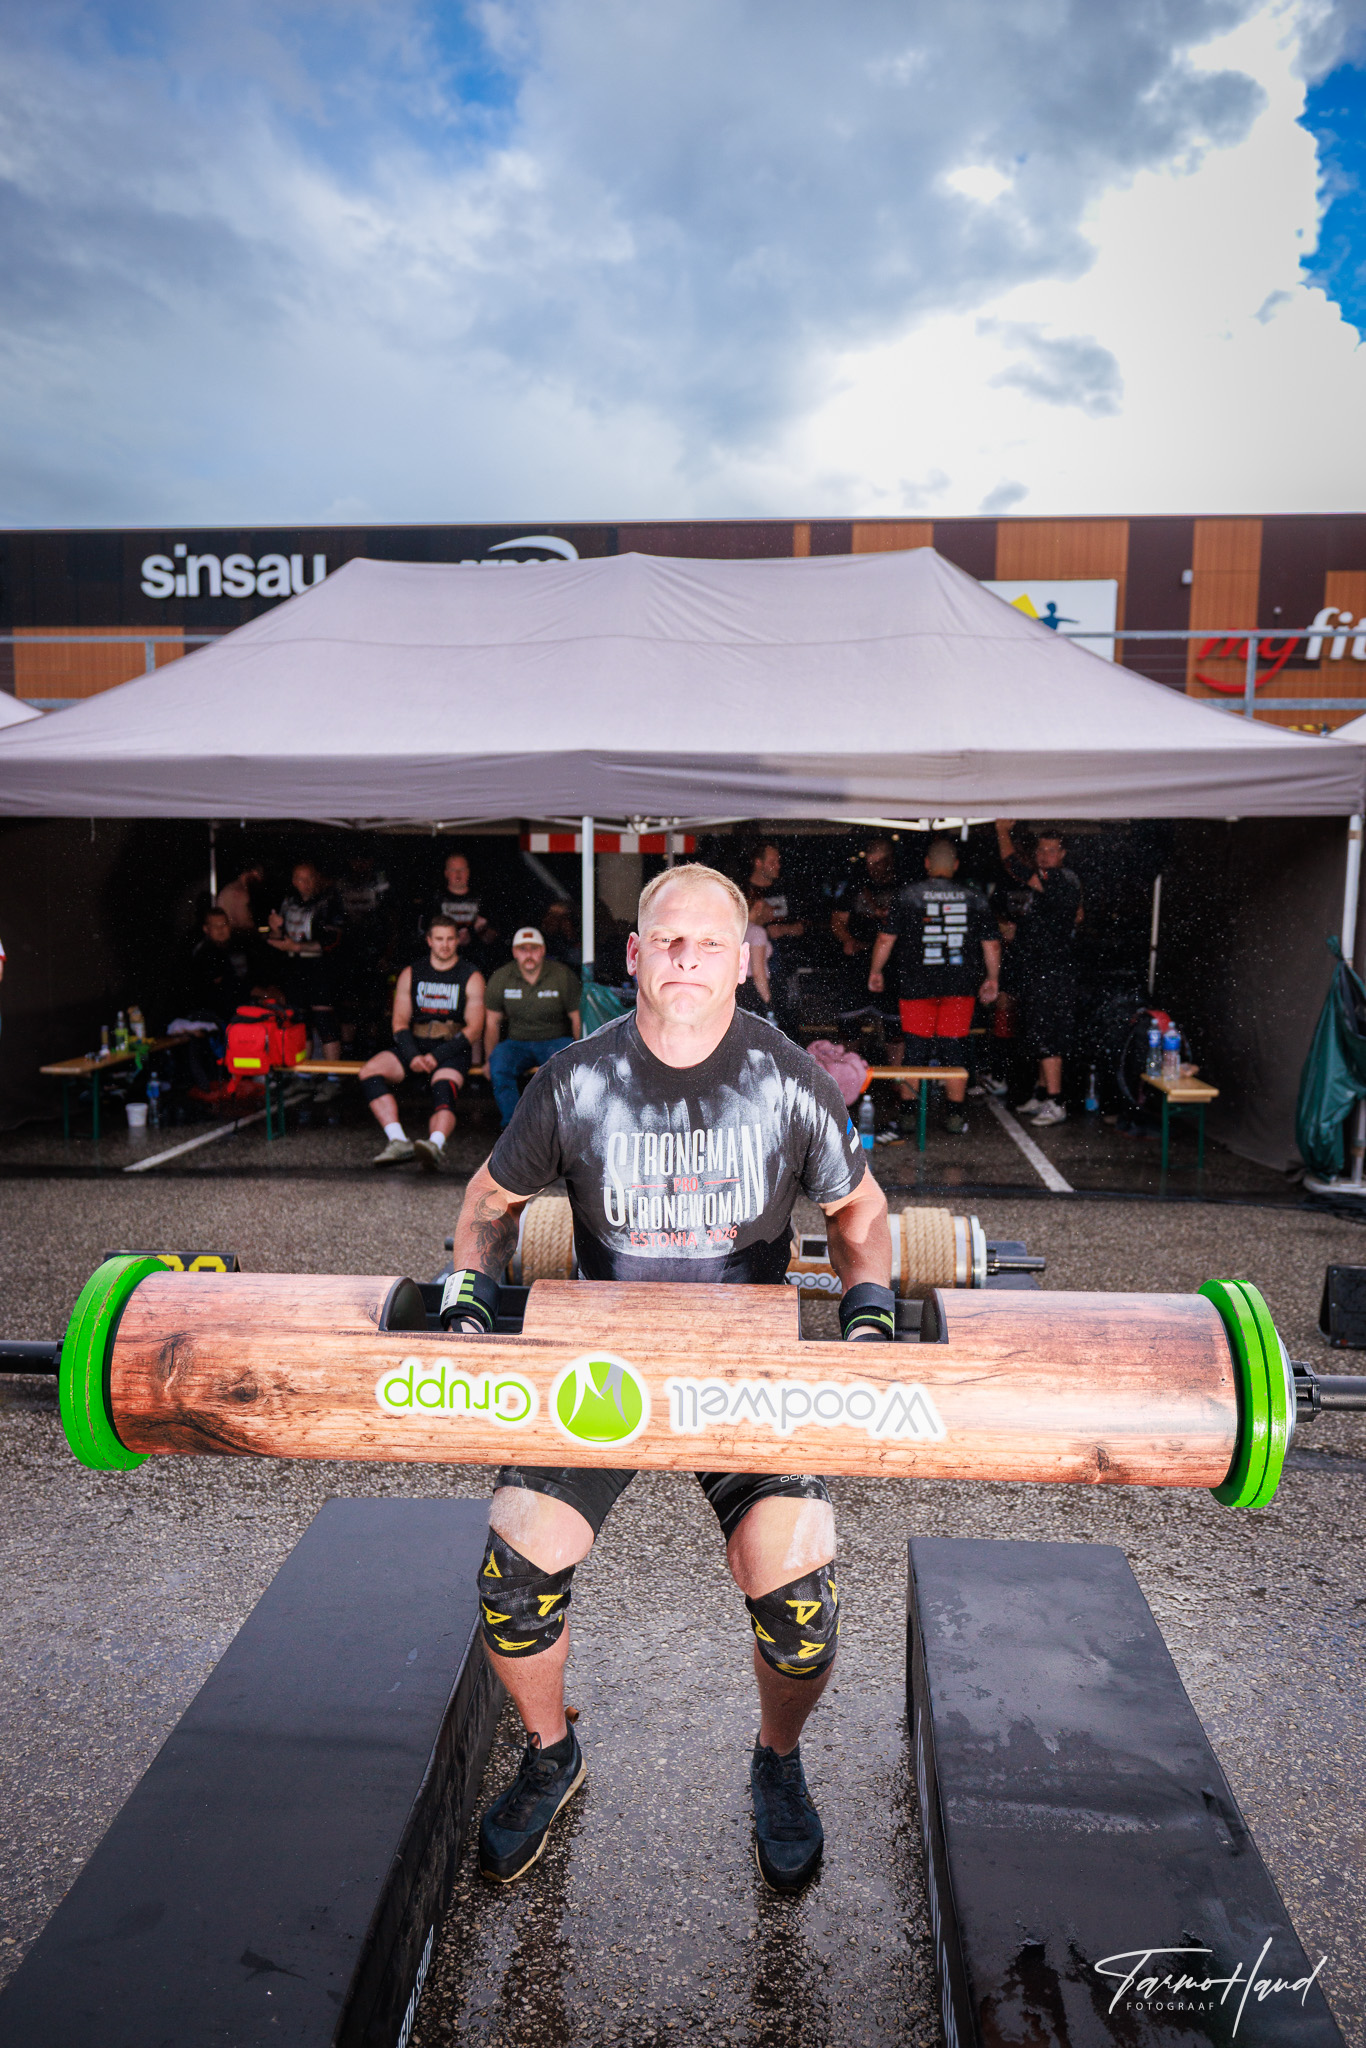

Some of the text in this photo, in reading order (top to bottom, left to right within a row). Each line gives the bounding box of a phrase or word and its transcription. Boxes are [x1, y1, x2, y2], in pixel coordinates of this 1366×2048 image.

[605, 1124, 764, 1188] STRONGMAN
[604, 1176, 764, 1229] STRONGWOMAN
[673, 1177, 699, 1192] PRO
[630, 1225, 738, 1248] ESTONIA 2026
[383, 1366, 939, 1434] Woodwell Grupp
